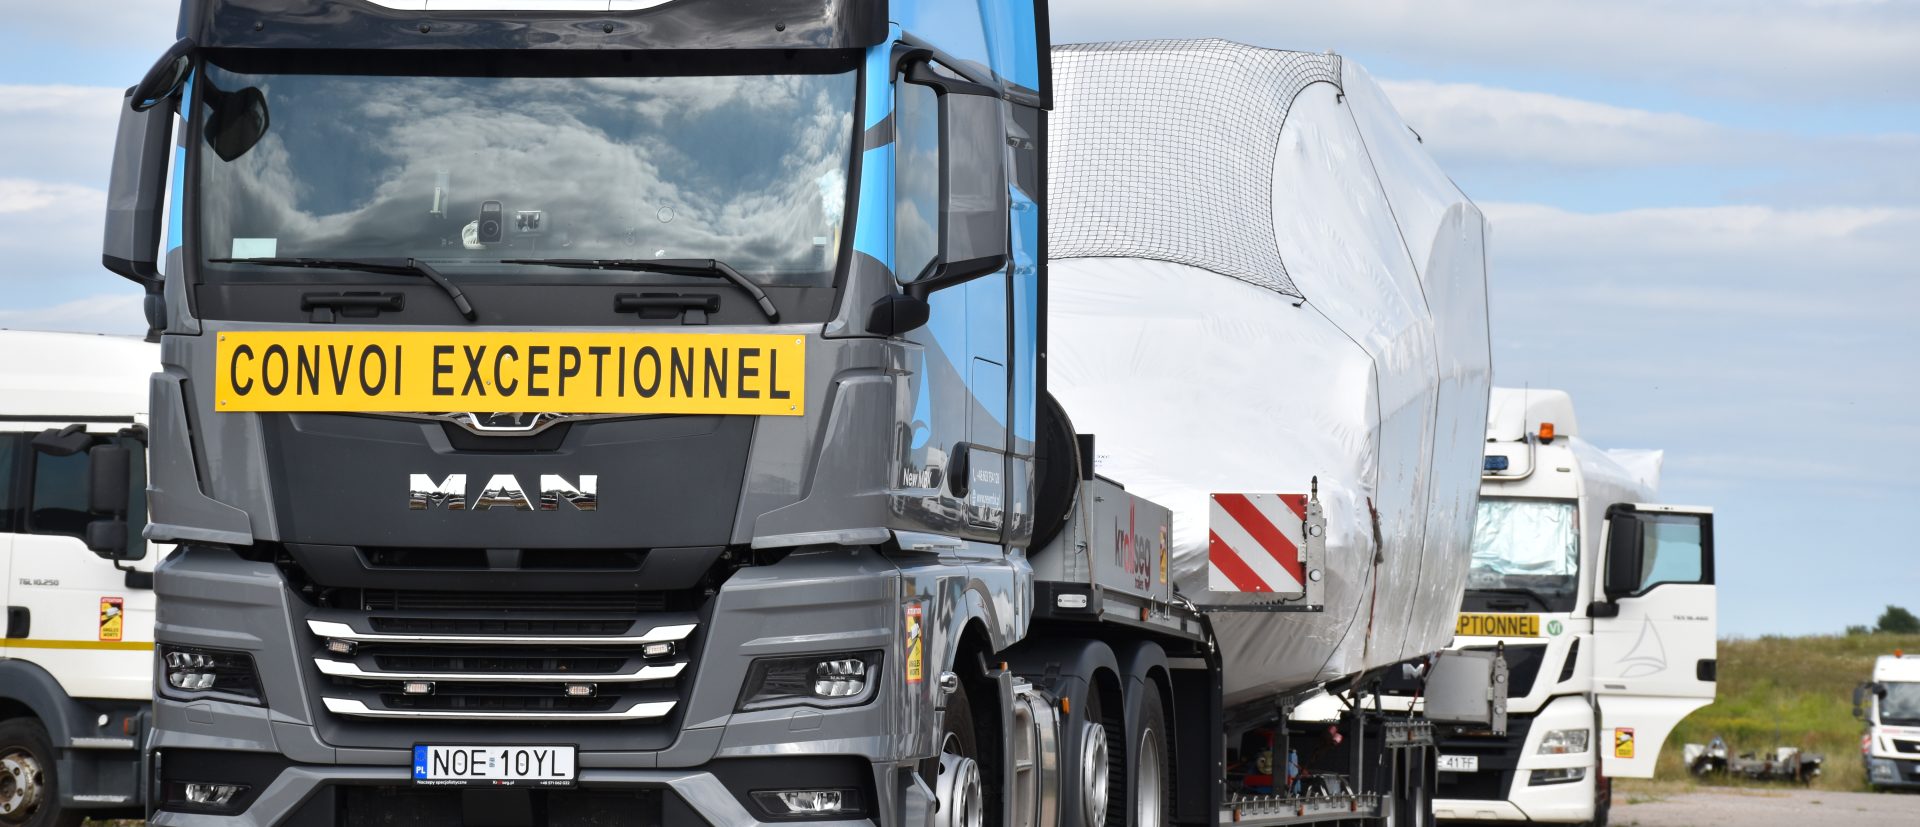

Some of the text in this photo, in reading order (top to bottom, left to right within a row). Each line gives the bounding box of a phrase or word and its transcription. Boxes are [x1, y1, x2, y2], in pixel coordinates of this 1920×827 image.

[230, 343, 791, 399] CONVOI EXCEPTIONNEL
[408, 474, 597, 511] MAN
[415, 766, 426, 774] PL
[433, 749, 566, 777] NOE 10YL
